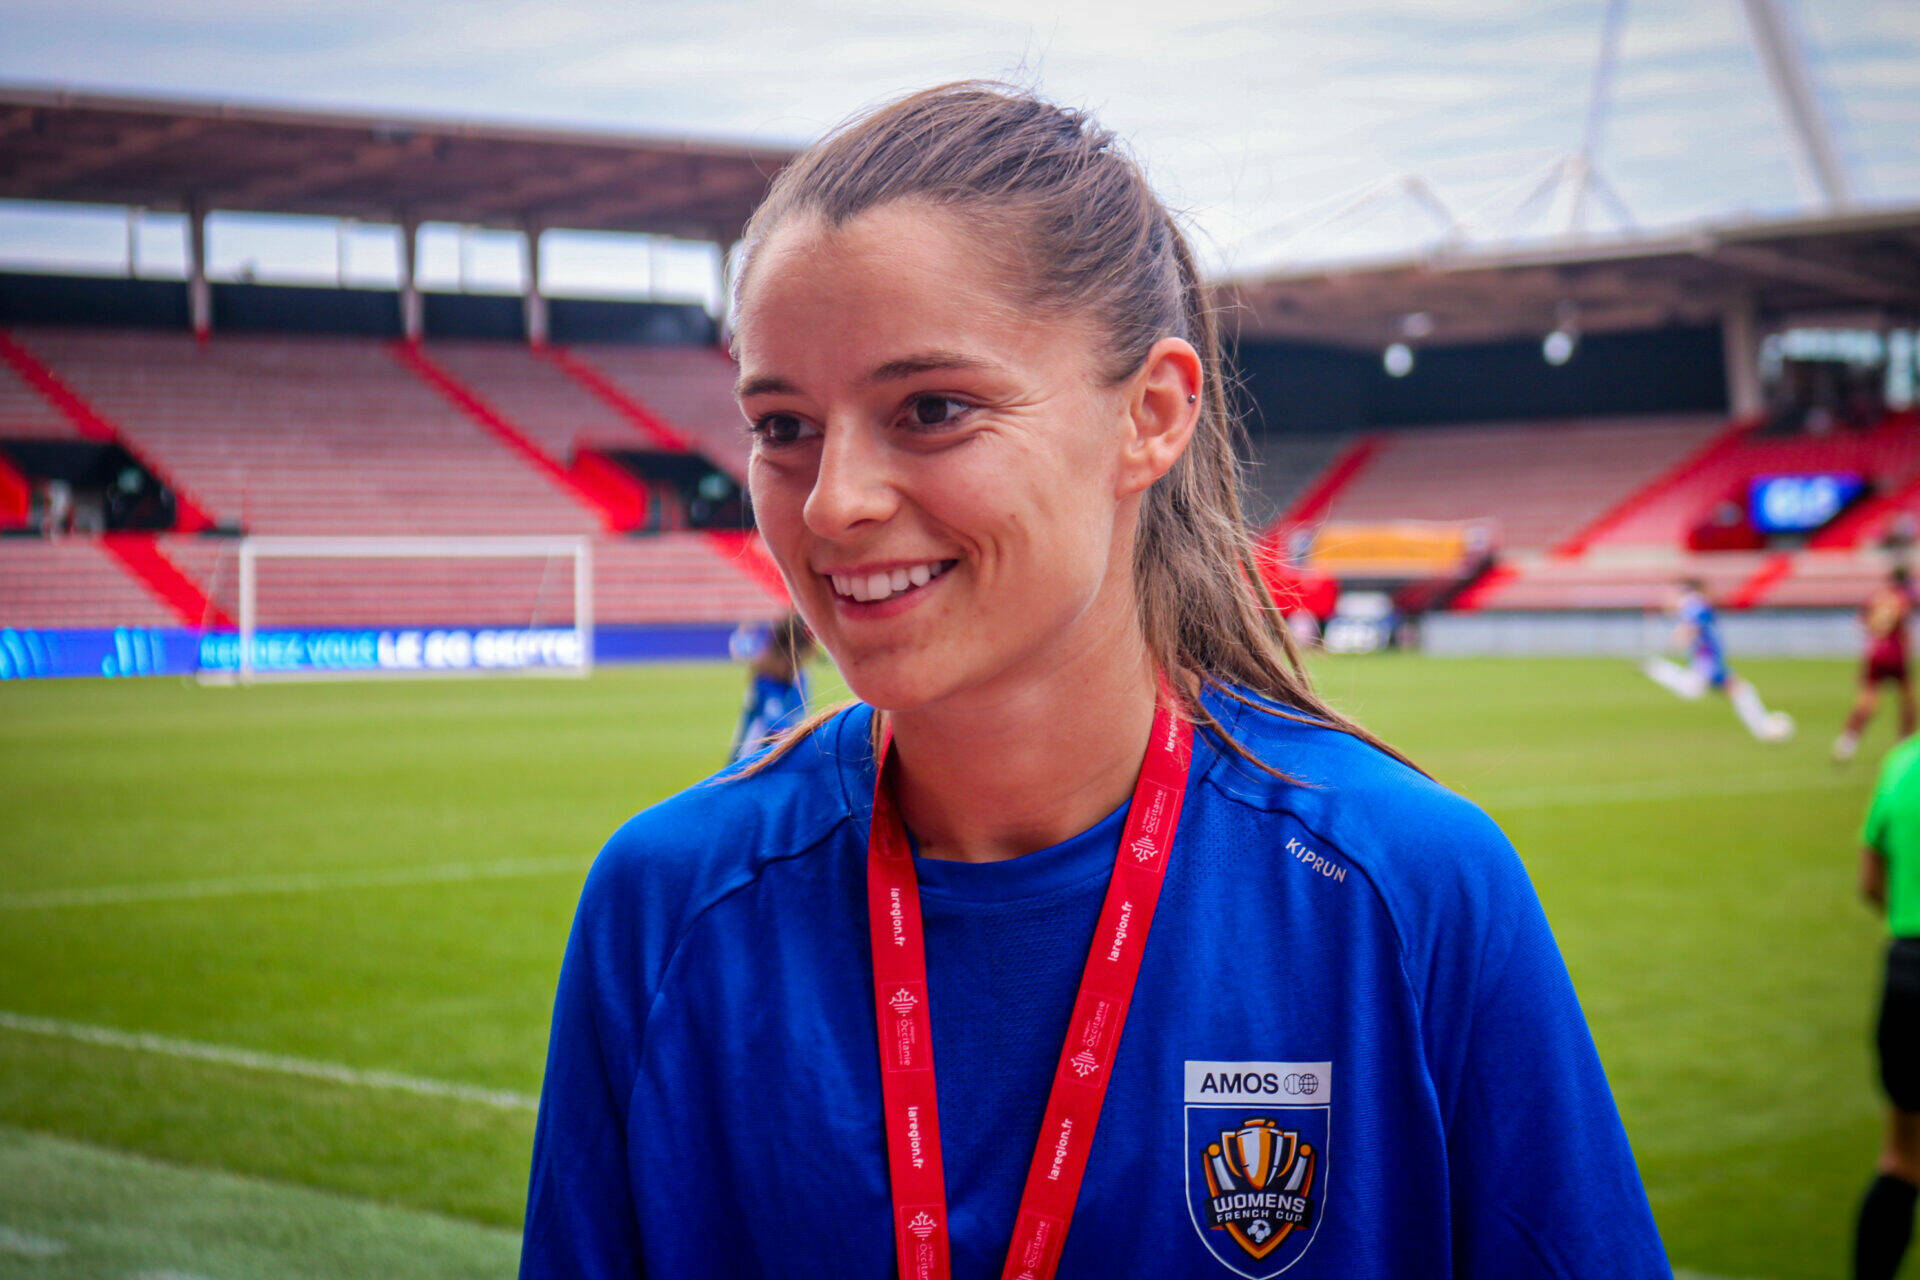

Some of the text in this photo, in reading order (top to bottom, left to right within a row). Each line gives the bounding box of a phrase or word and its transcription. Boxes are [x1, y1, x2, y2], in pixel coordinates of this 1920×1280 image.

[1146, 789, 1163, 833] Occitanie
[1285, 837, 1347, 883] KIPRUN
[890, 887, 906, 946] laregion.fr
[1107, 900, 1133, 961] laregion.fr
[1086, 1000, 1106, 1047] Occitanie
[1200, 1072, 1279, 1094] AMOS
[907, 1106, 924, 1169] laregion.fr
[1048, 1118, 1073, 1181] laregion.fr
[1213, 1193, 1306, 1213] WOMENS
[1216, 1209, 1303, 1223] FRENCH CUP
